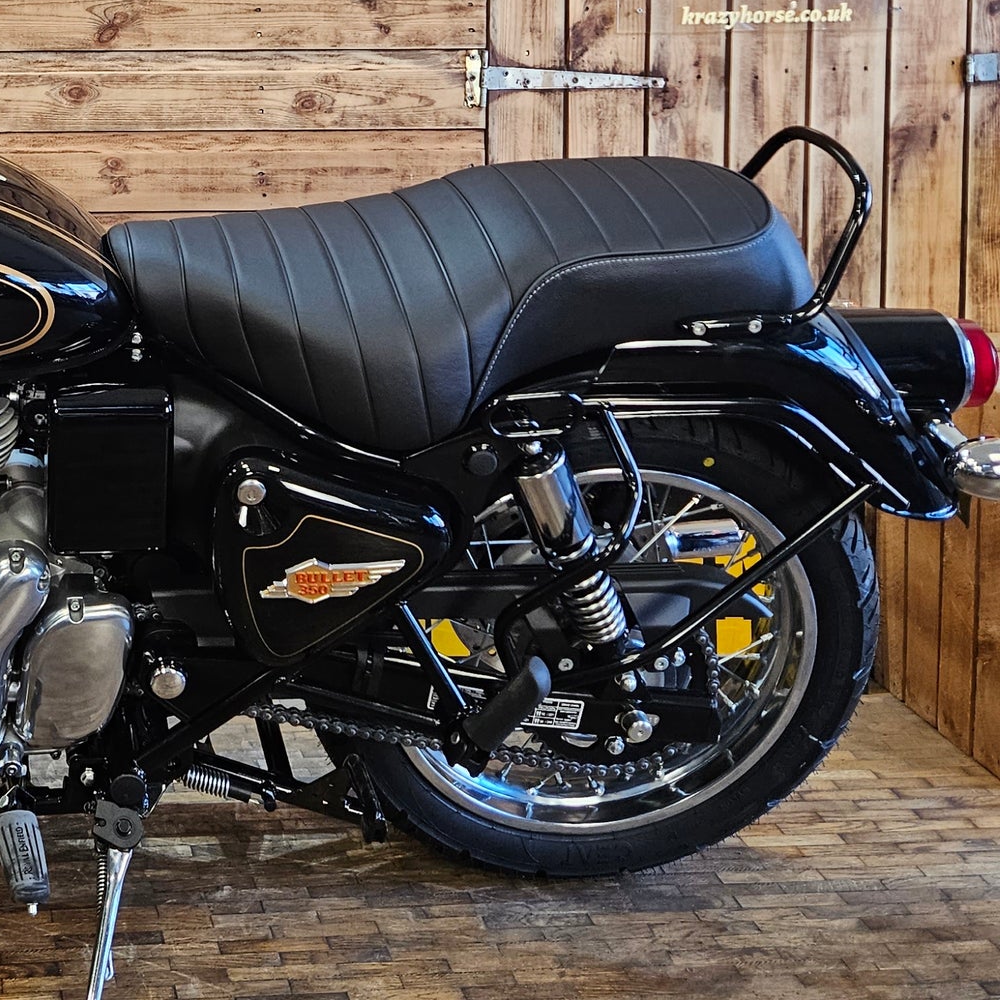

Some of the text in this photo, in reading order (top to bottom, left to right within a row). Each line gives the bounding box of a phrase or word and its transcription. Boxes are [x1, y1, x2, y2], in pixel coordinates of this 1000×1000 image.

[681, 2, 853, 30] krazyhorse.co.uk
[294, 571, 370, 584] BULLET
[297, 584, 328, 595] 350
